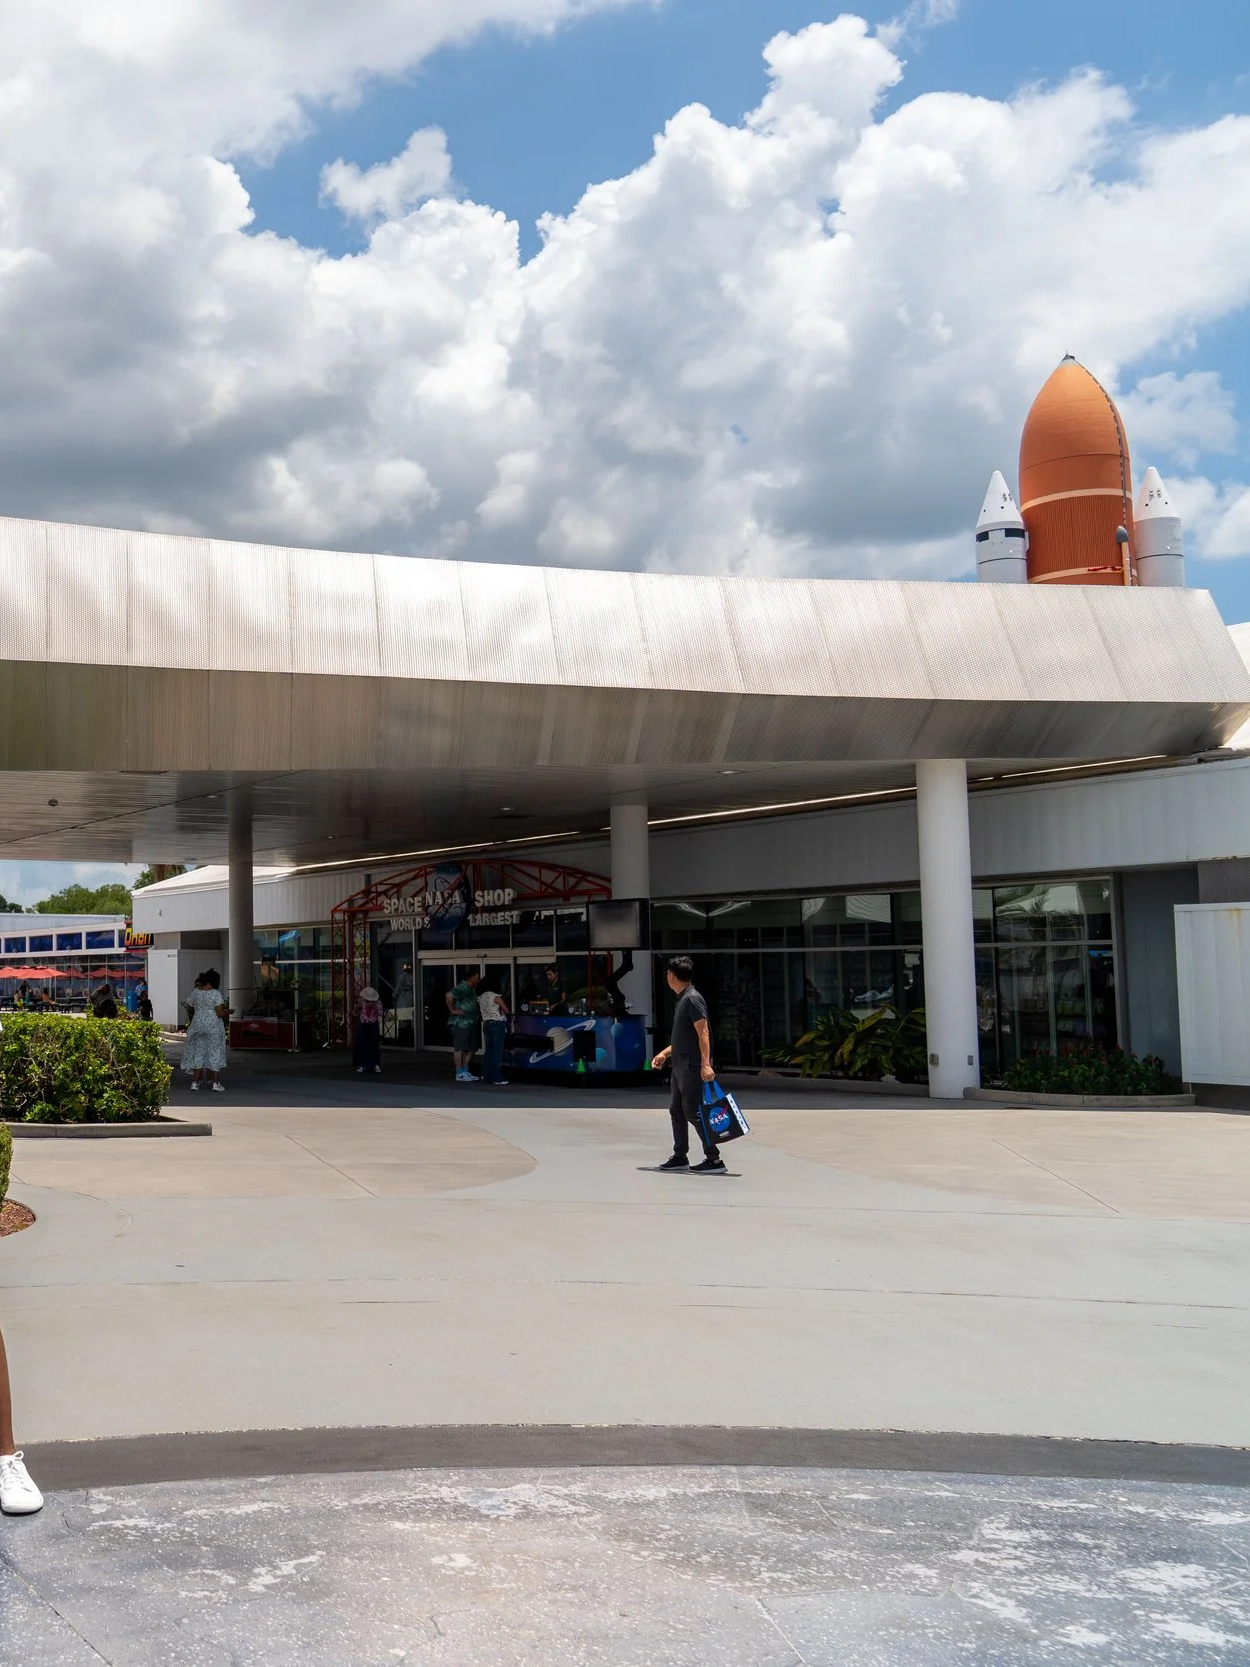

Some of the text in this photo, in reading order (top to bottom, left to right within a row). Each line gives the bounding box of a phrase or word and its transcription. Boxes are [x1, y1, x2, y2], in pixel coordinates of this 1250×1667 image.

[383, 888, 515, 914] SPACE SHOP
[426, 889, 462, 906] NASA
[390, 911, 521, 931] WORLDS LARGEST
